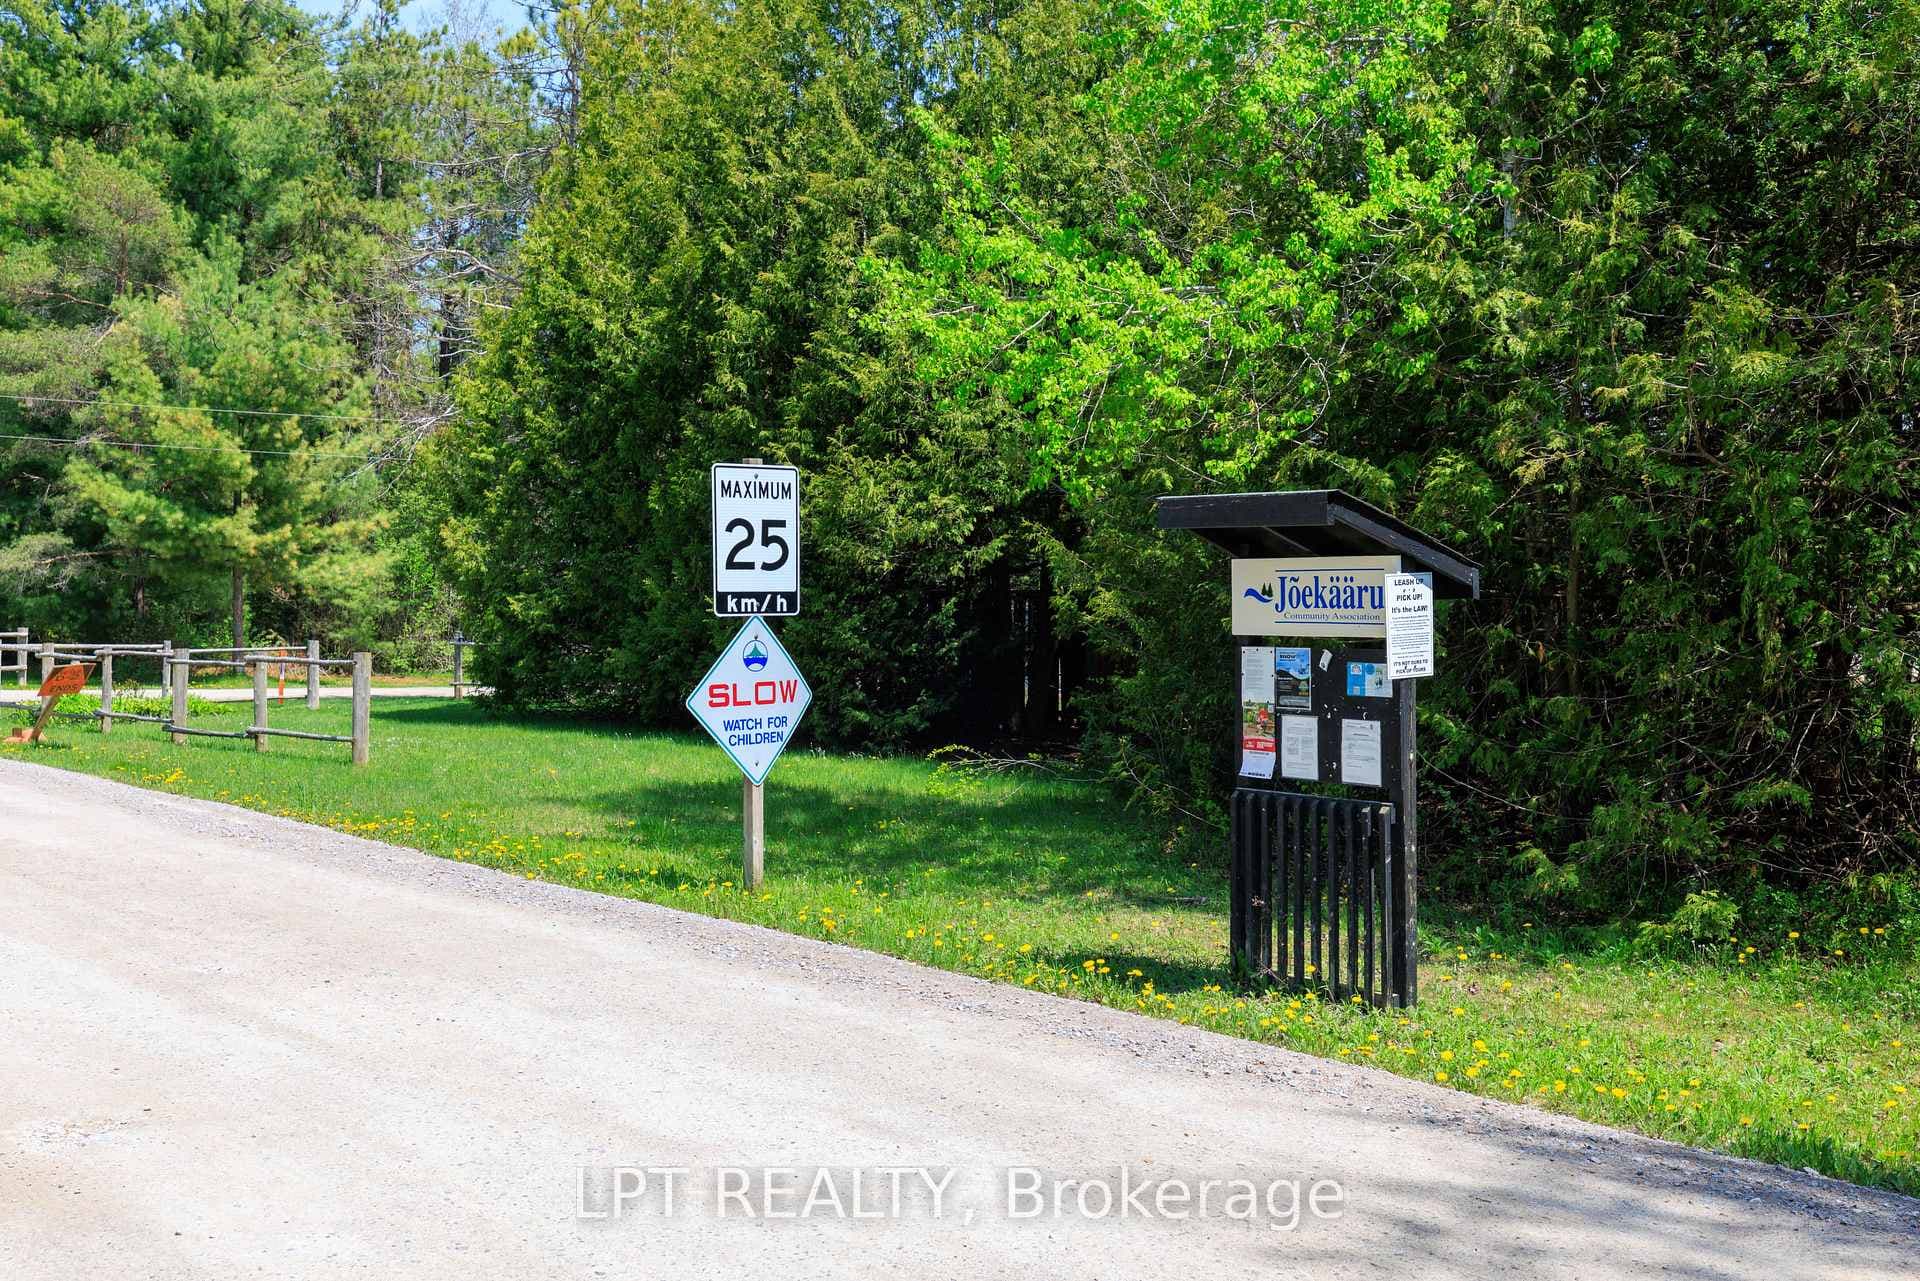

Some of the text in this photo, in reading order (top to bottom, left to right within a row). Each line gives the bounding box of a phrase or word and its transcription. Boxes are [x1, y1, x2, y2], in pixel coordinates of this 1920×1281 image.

[720, 480, 792, 500] MAXIMUM
[725, 517, 790, 571] 25
[1394, 577, 1424, 586] LEASH UP
[1275, 575, 1385, 613] Jõekääru
[1396, 592, 1423, 602] PICK UP!
[726, 593, 788, 614] km/h
[1413, 604, 1429, 612] LAW!
[1284, 611, 1381, 622] Community Association
[708, 679, 798, 708] SLOW
[723, 715, 788, 733] WATCH FOR
[728, 731, 784, 747] CHILDREN
